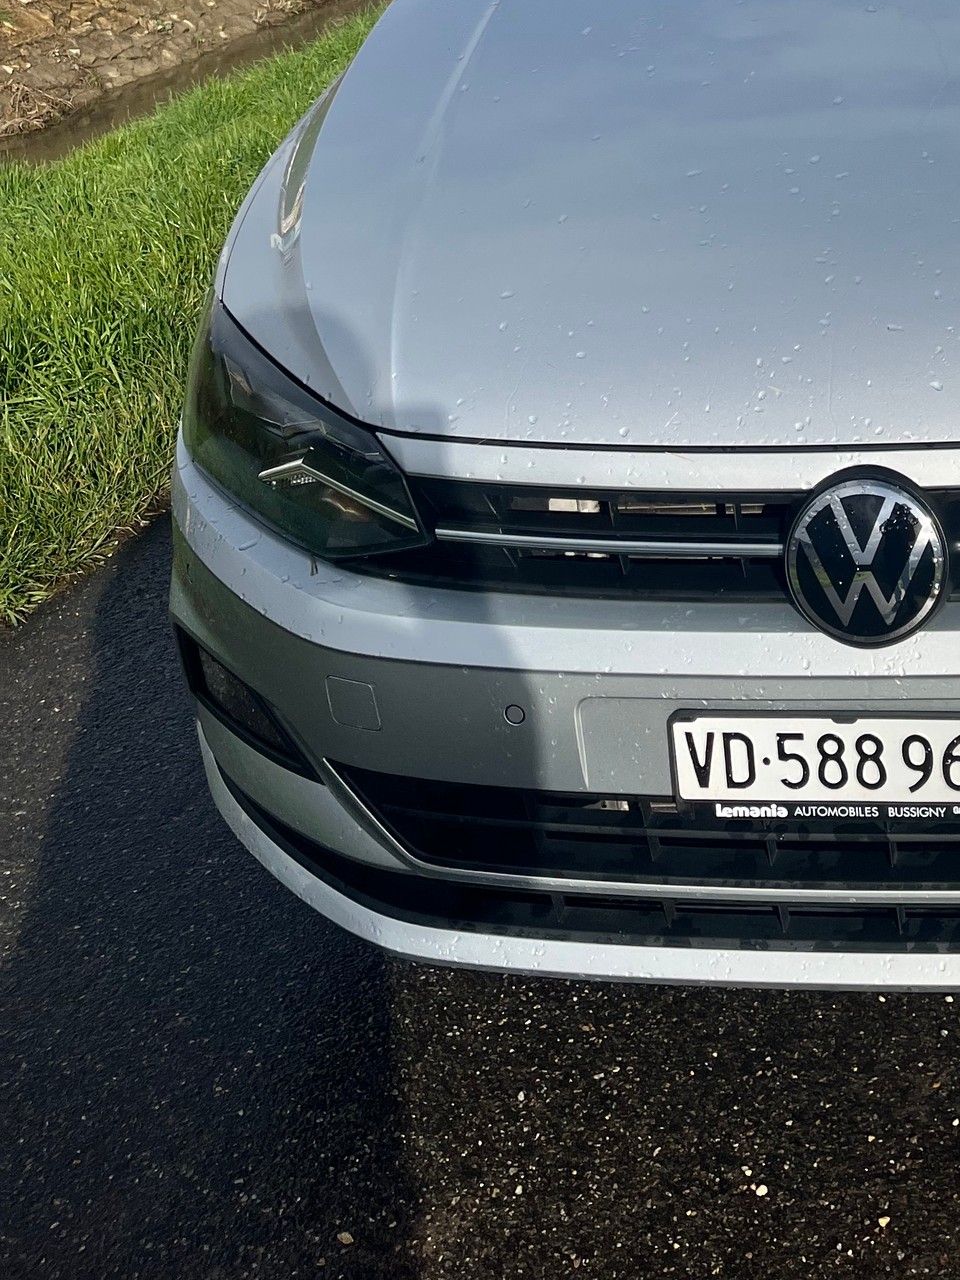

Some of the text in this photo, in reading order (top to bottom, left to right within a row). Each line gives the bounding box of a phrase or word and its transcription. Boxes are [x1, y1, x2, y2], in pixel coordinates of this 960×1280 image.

[714, 803, 789, 818] Lemania
[793, 806, 880, 818] AUTOMOBILES
[887, 806, 947, 818] BUSSIGNY
